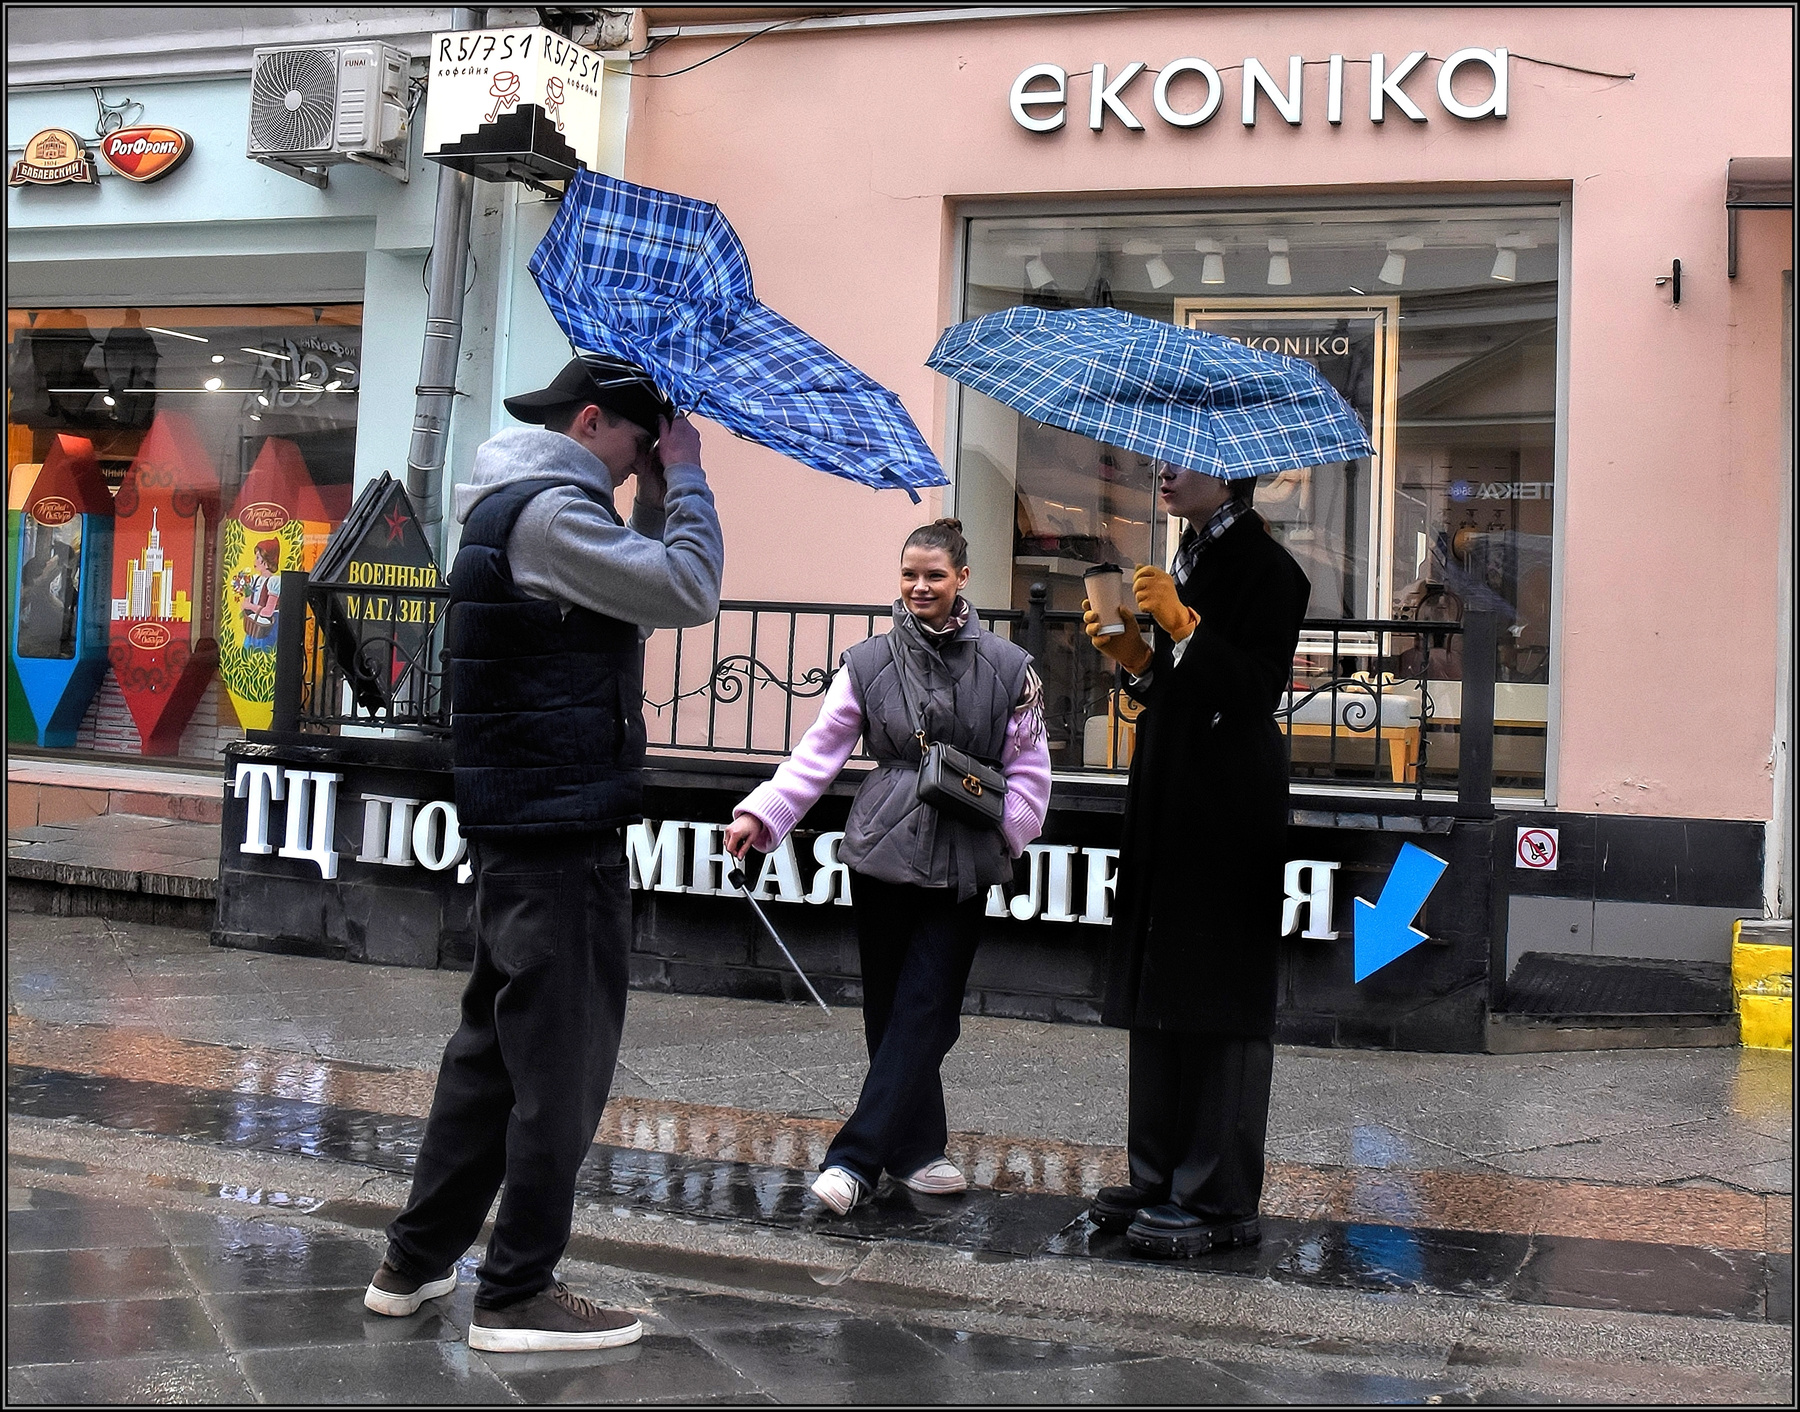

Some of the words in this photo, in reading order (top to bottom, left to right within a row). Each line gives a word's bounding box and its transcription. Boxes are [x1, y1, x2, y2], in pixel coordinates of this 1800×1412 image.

[438, 66, 489, 77] кофейня
[567, 77, 598, 98] кофейня
[20, 162, 79, 180] БАБАЕВСКИЙ
[348, 561, 437, 588] ВОЕННЫЙ
[234, 762, 344, 880] ТЦ
